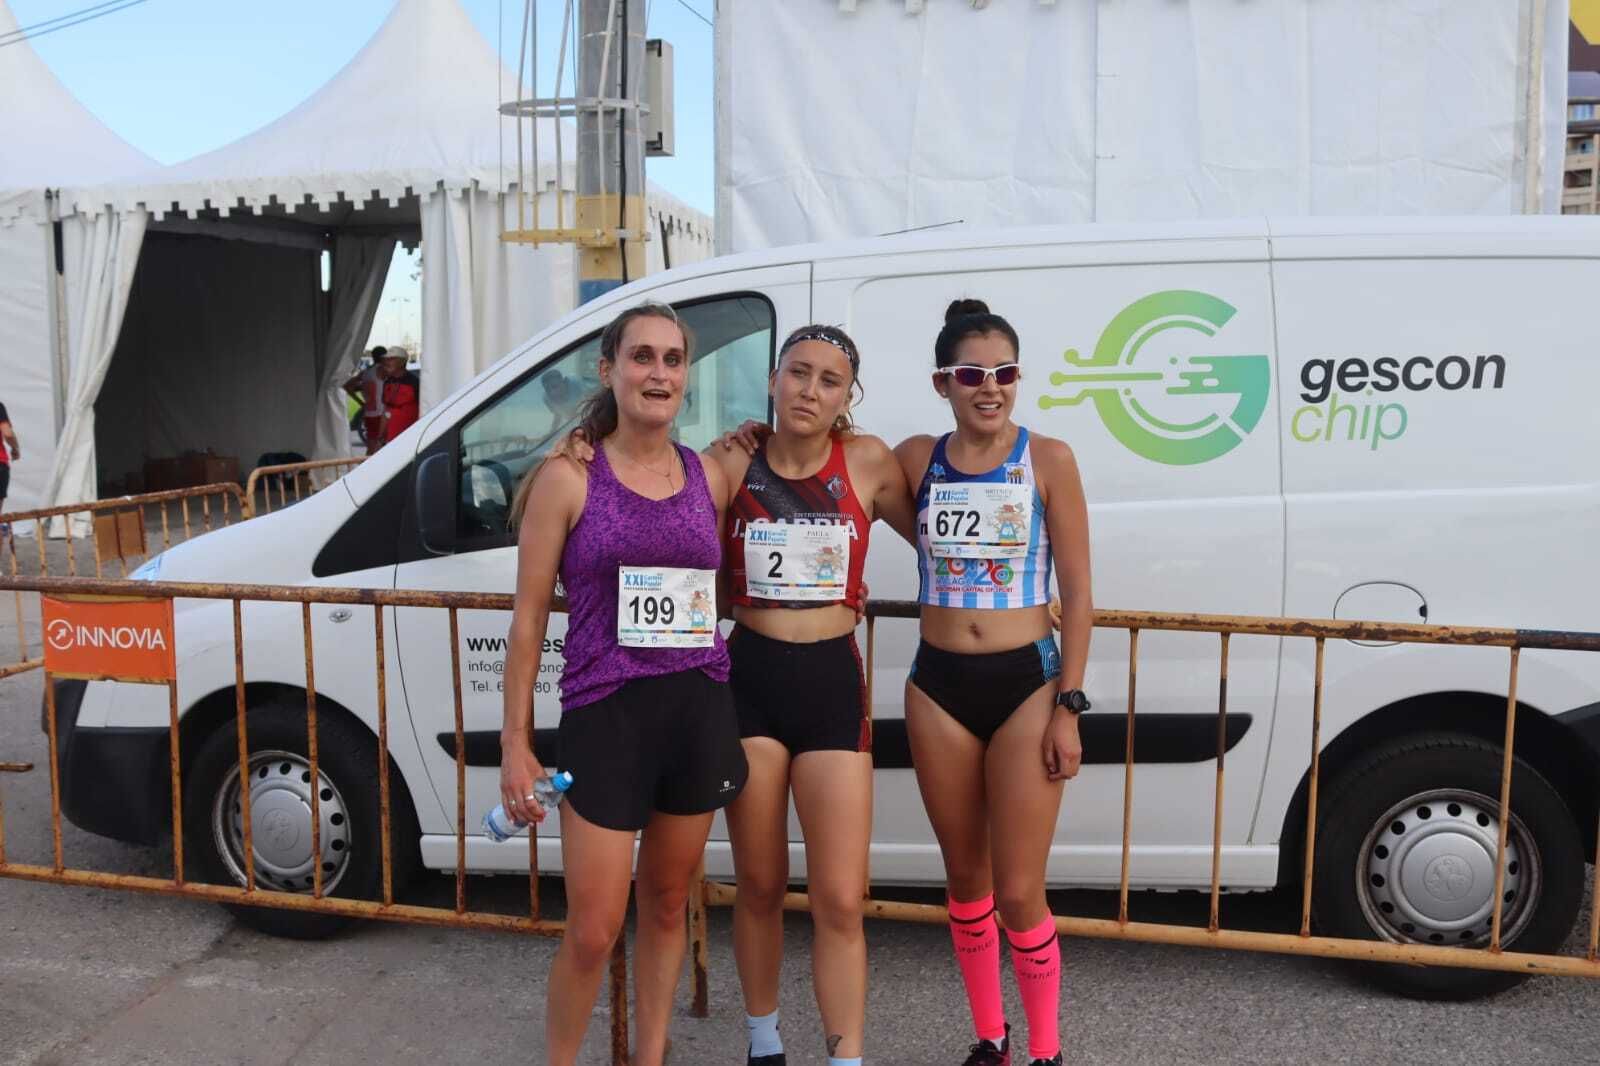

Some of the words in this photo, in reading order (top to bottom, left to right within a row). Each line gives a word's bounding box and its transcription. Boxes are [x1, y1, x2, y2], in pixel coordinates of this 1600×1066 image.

[1300, 354, 1507, 404] gescon
[1291, 389, 1408, 451] chip
[935, 491, 950, 502] XXI
[750, 530, 768, 541] XXI
[935, 510, 981, 537] 672
[767, 551, 783, 578] 2
[624, 574, 643, 587] XXI
[628, 595, 675, 625] 199
[76, 625, 167, 651] INNOVIA
[470, 680, 493, 693] Tel.
